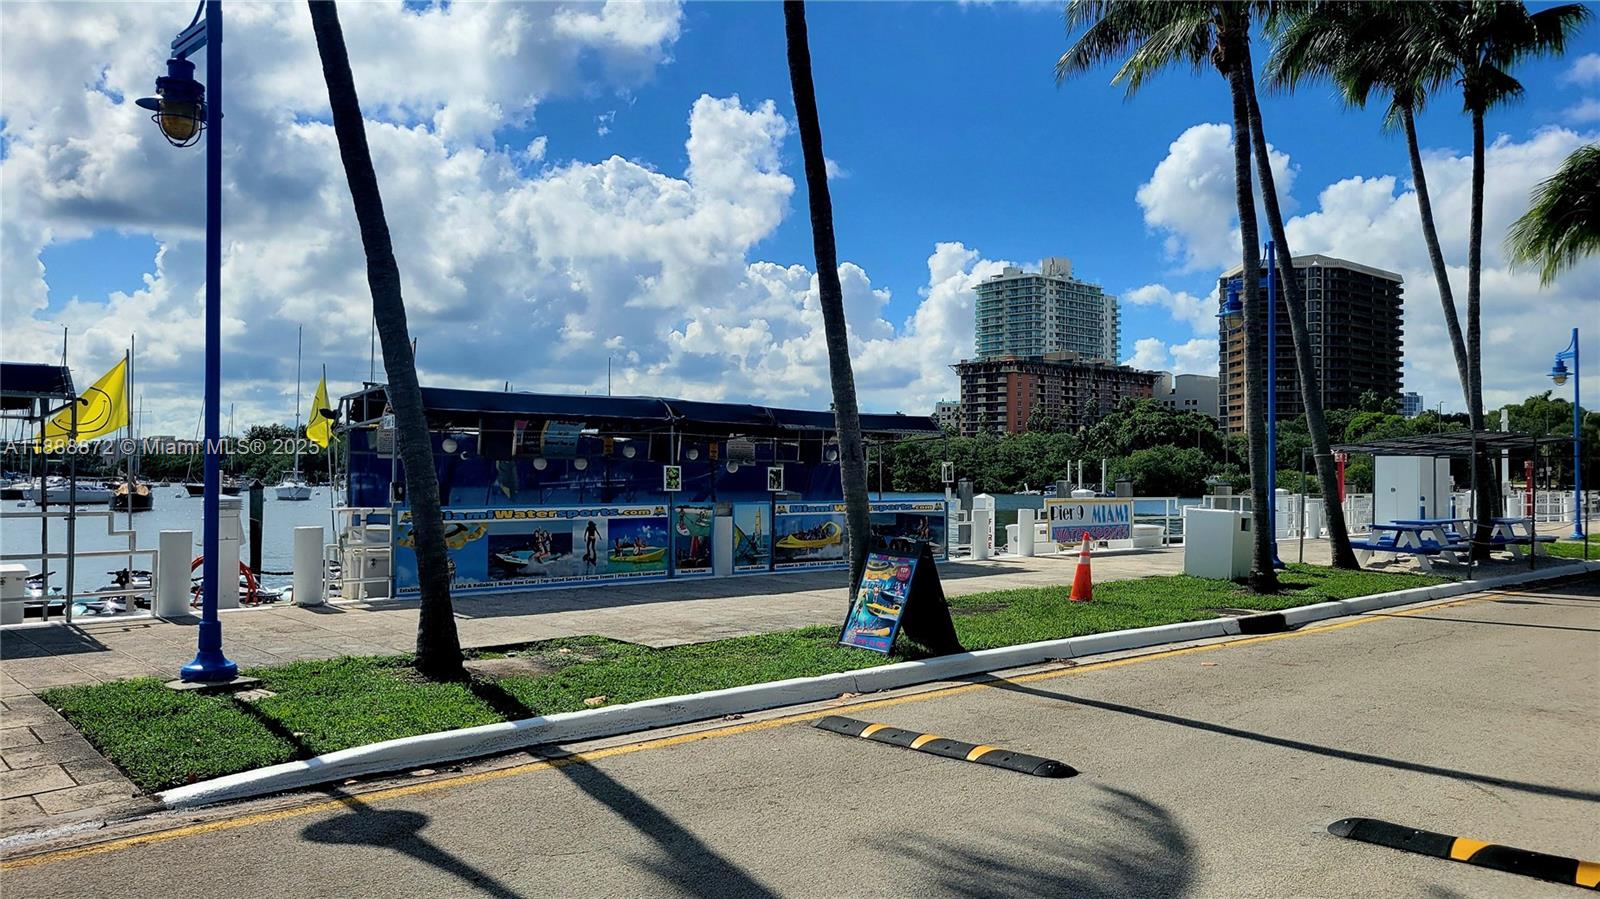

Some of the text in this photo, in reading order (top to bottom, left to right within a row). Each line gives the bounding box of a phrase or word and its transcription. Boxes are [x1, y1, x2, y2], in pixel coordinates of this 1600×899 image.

[443, 507, 651, 520] iamiWatersports.com
[1050, 504, 1129, 522] Pier 9 MIAMI
